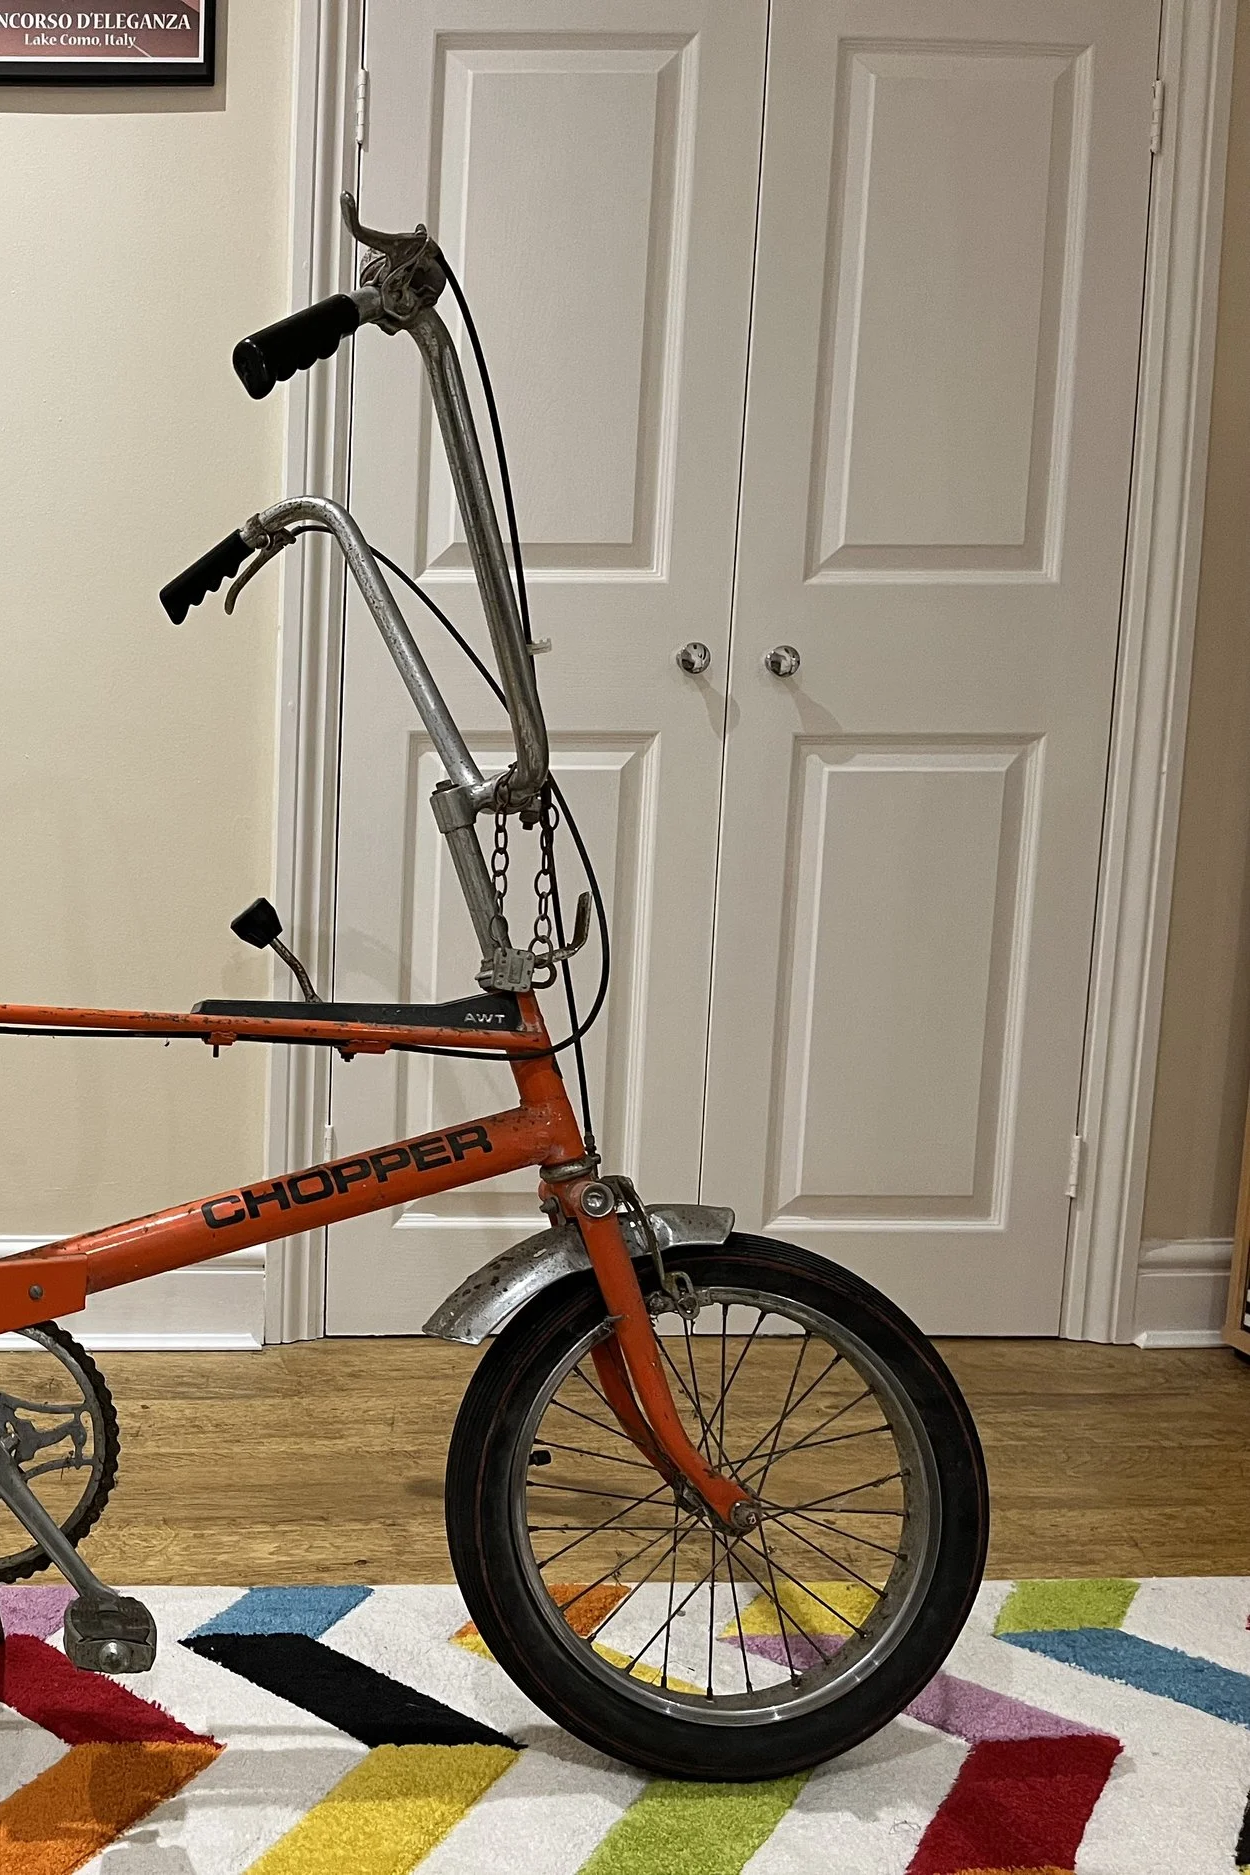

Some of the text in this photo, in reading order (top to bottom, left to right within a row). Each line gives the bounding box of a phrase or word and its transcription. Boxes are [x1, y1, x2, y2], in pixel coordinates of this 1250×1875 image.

[76, 12, 192, 31] D'ELEGANZA
[24, 33, 137, 49] Lake Como, Italy
[463, 1013, 506, 1024] AWT
[201, 1125, 494, 1230] CHOPPER
